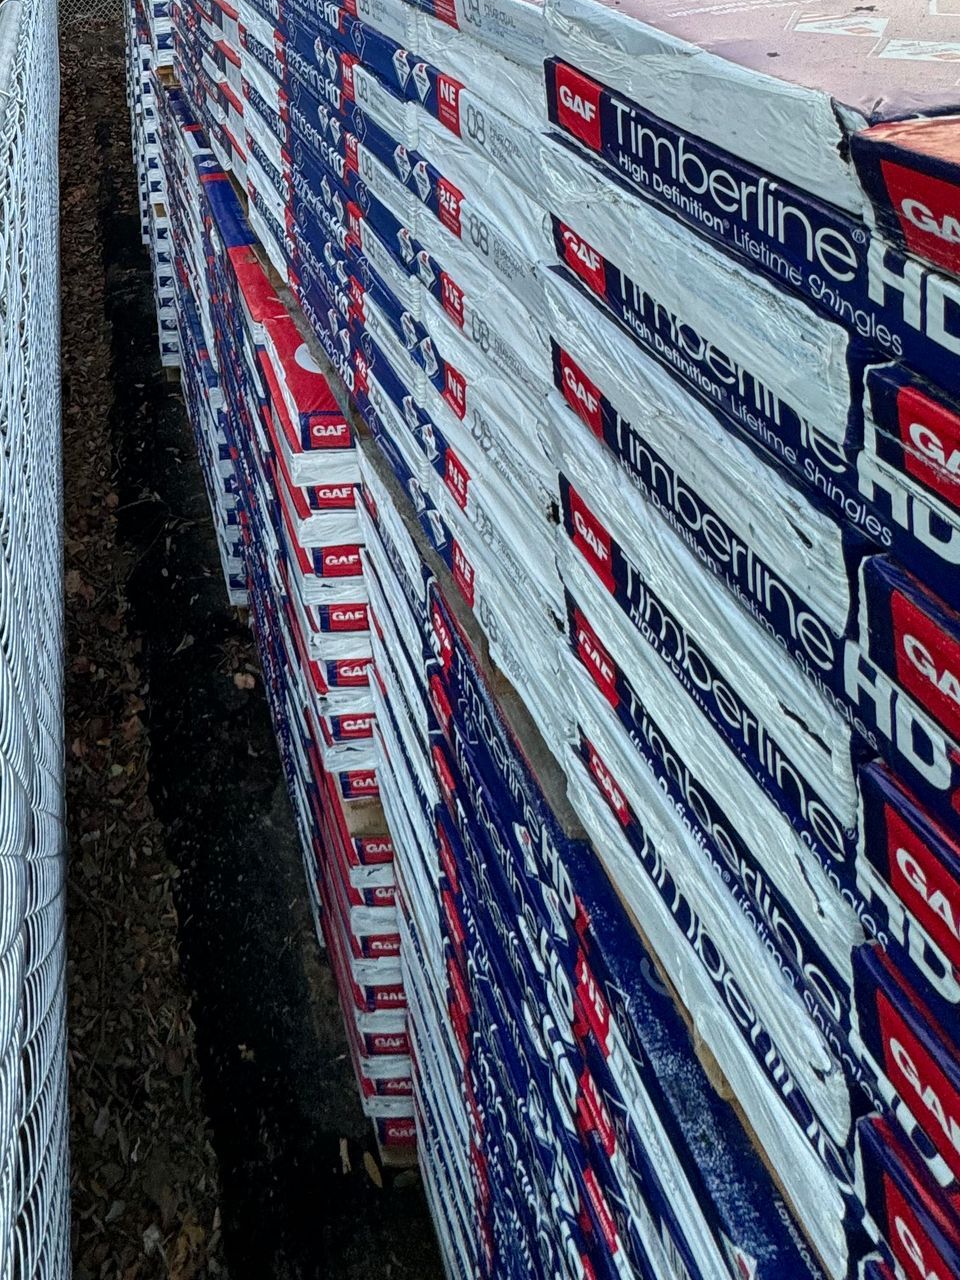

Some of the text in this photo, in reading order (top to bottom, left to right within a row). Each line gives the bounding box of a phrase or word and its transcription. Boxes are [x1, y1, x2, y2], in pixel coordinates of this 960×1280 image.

[440, 80, 456, 107] NE
[559, 85, 596, 122] GAF
[469, 212, 490, 256] 08
[901, 198, 960, 245] GA
[563, 231, 601, 272] GAF
[619, 150, 649, 185] High
[733, 224, 803, 286] Lifetime
[808, 274, 903, 356] Shingles
[444, 278, 460, 309] NE
[867, 237, 960, 355] HD
[447, 374, 465, 406] NE
[563, 366, 598, 414] GAF
[312, 423, 347, 437] GAF
[622, 305, 652, 341] High
[730, 395, 798, 464] Lifetime
[803, 458, 892, 546] Shingles
[448, 460, 466, 492] NE
[908, 422, 960, 486] GA
[319, 486, 352, 499] GAF
[856, 449, 960, 566] HD
[573, 510, 609, 561] GAF
[325, 554, 359, 566] GAF
[454, 549, 472, 582] NE
[332, 611, 364, 621] GAF
[616, 412, 835, 672] Timberline
[843, 638, 952, 791] HD
[902, 633, 960, 707] GA
[895, 847, 960, 940] GA
[889, 1036, 960, 1154] GA
